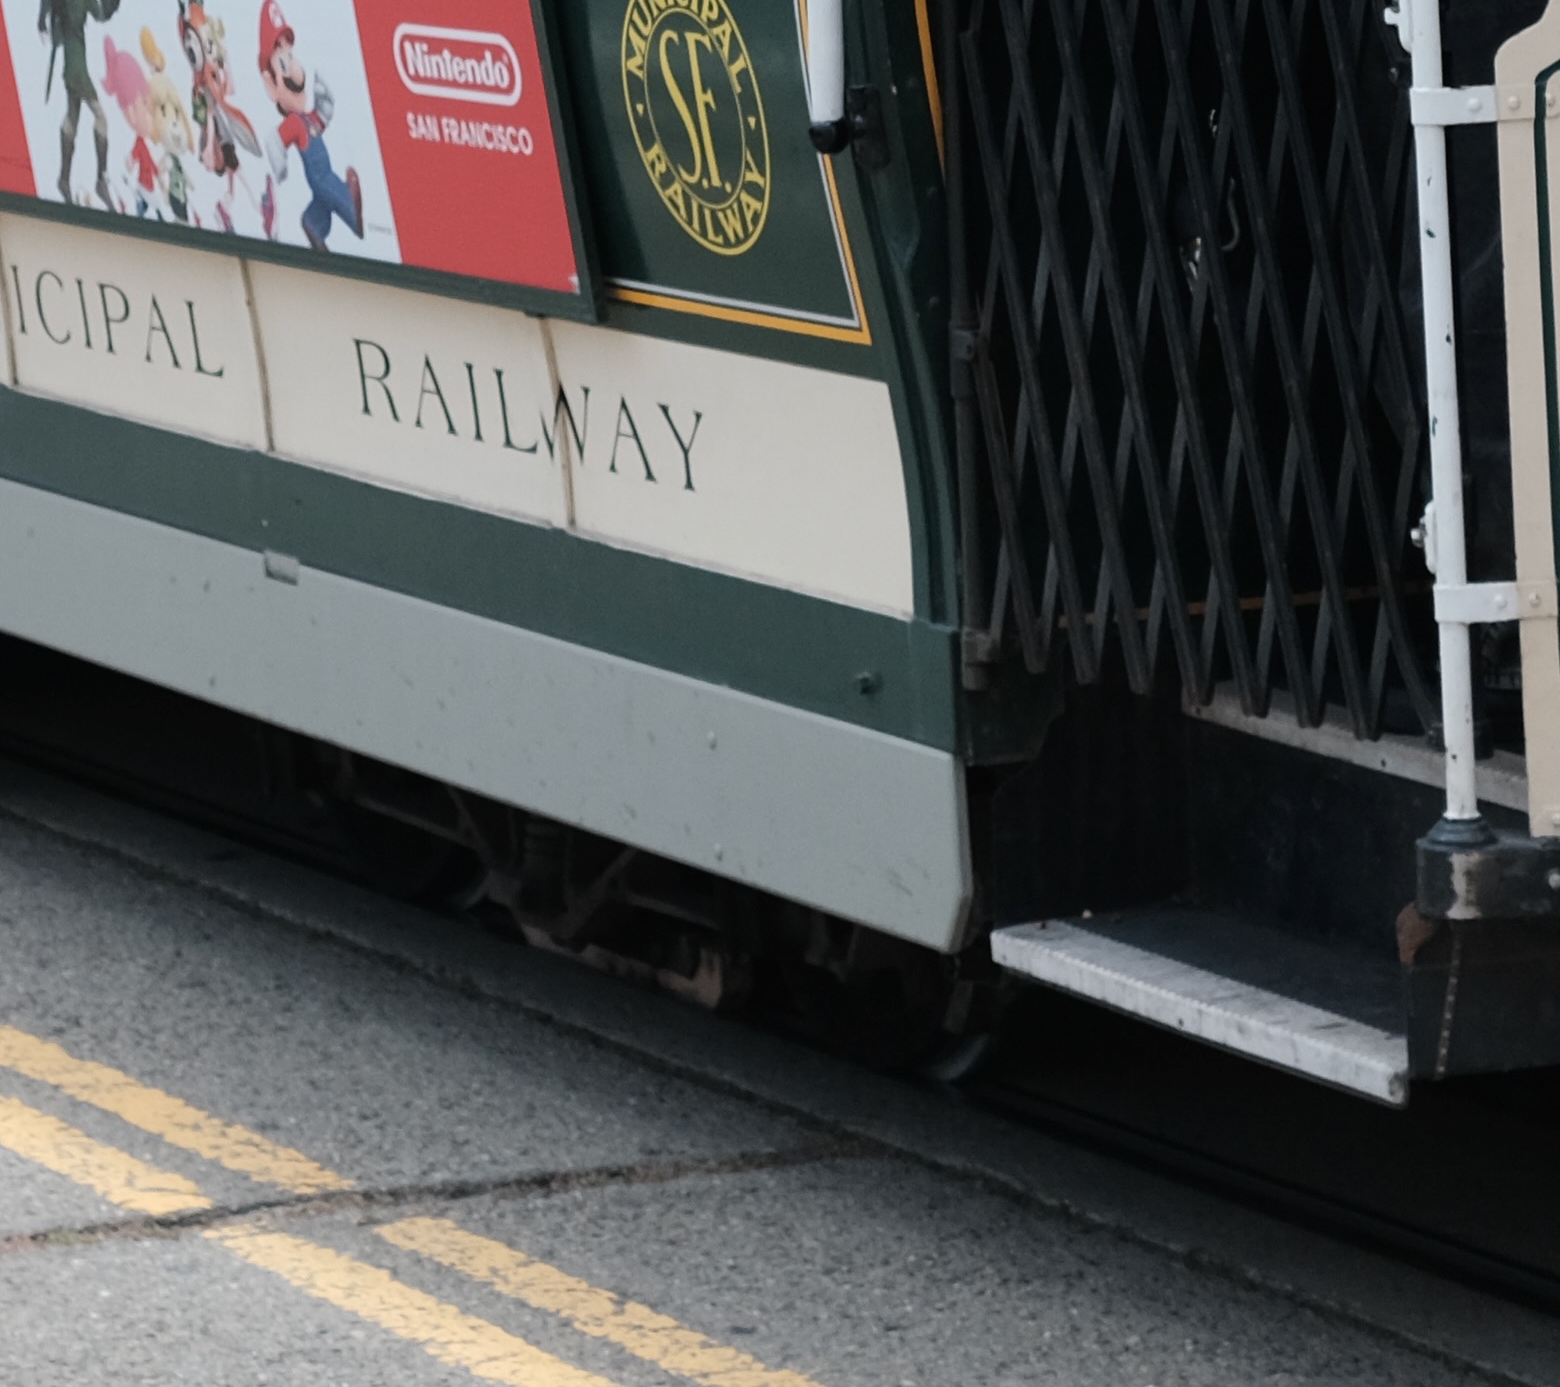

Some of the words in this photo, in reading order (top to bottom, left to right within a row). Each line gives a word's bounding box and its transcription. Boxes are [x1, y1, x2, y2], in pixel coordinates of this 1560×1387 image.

[403, 40, 510, 89] Nintendo
[406, 112, 440, 143] SAN
[443, 115, 534, 156] FRANCISCO
[643, 142, 767, 246] RAILWAY
[353, 337, 703, 492] RAILWAY
